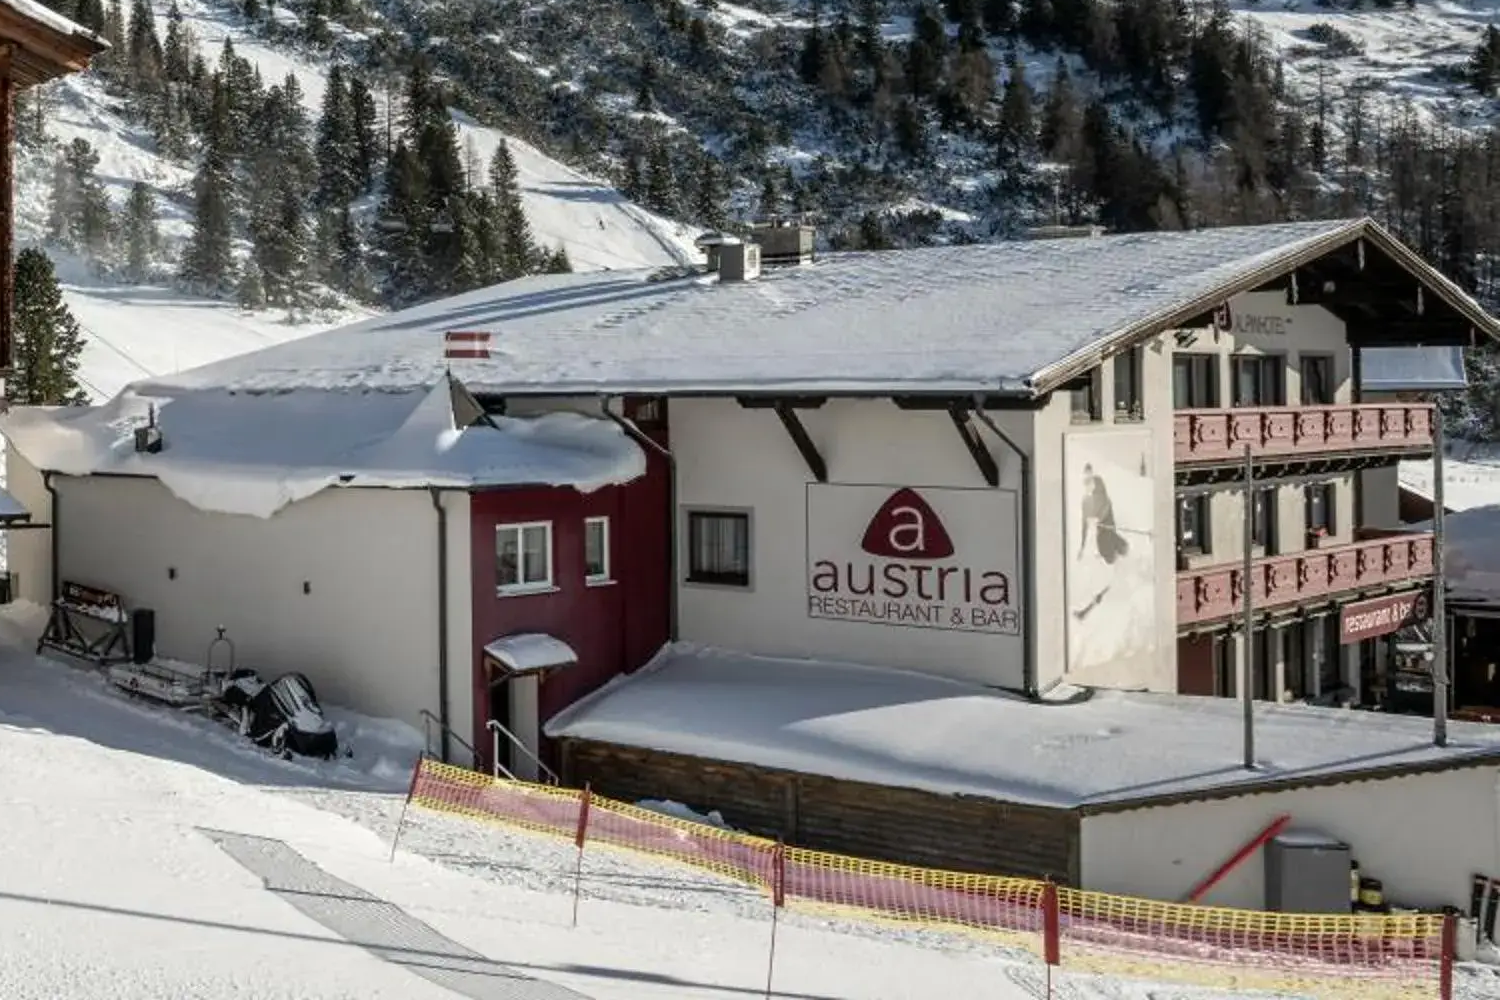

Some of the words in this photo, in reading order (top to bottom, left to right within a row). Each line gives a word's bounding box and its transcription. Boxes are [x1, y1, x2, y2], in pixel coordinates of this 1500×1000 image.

[889, 506, 925, 551] a
[812, 560, 1010, 606] austria
[809, 596, 944, 623] RESTAURANT
[949, 607, 965, 626] &
[971, 607, 1018, 630] BAR
